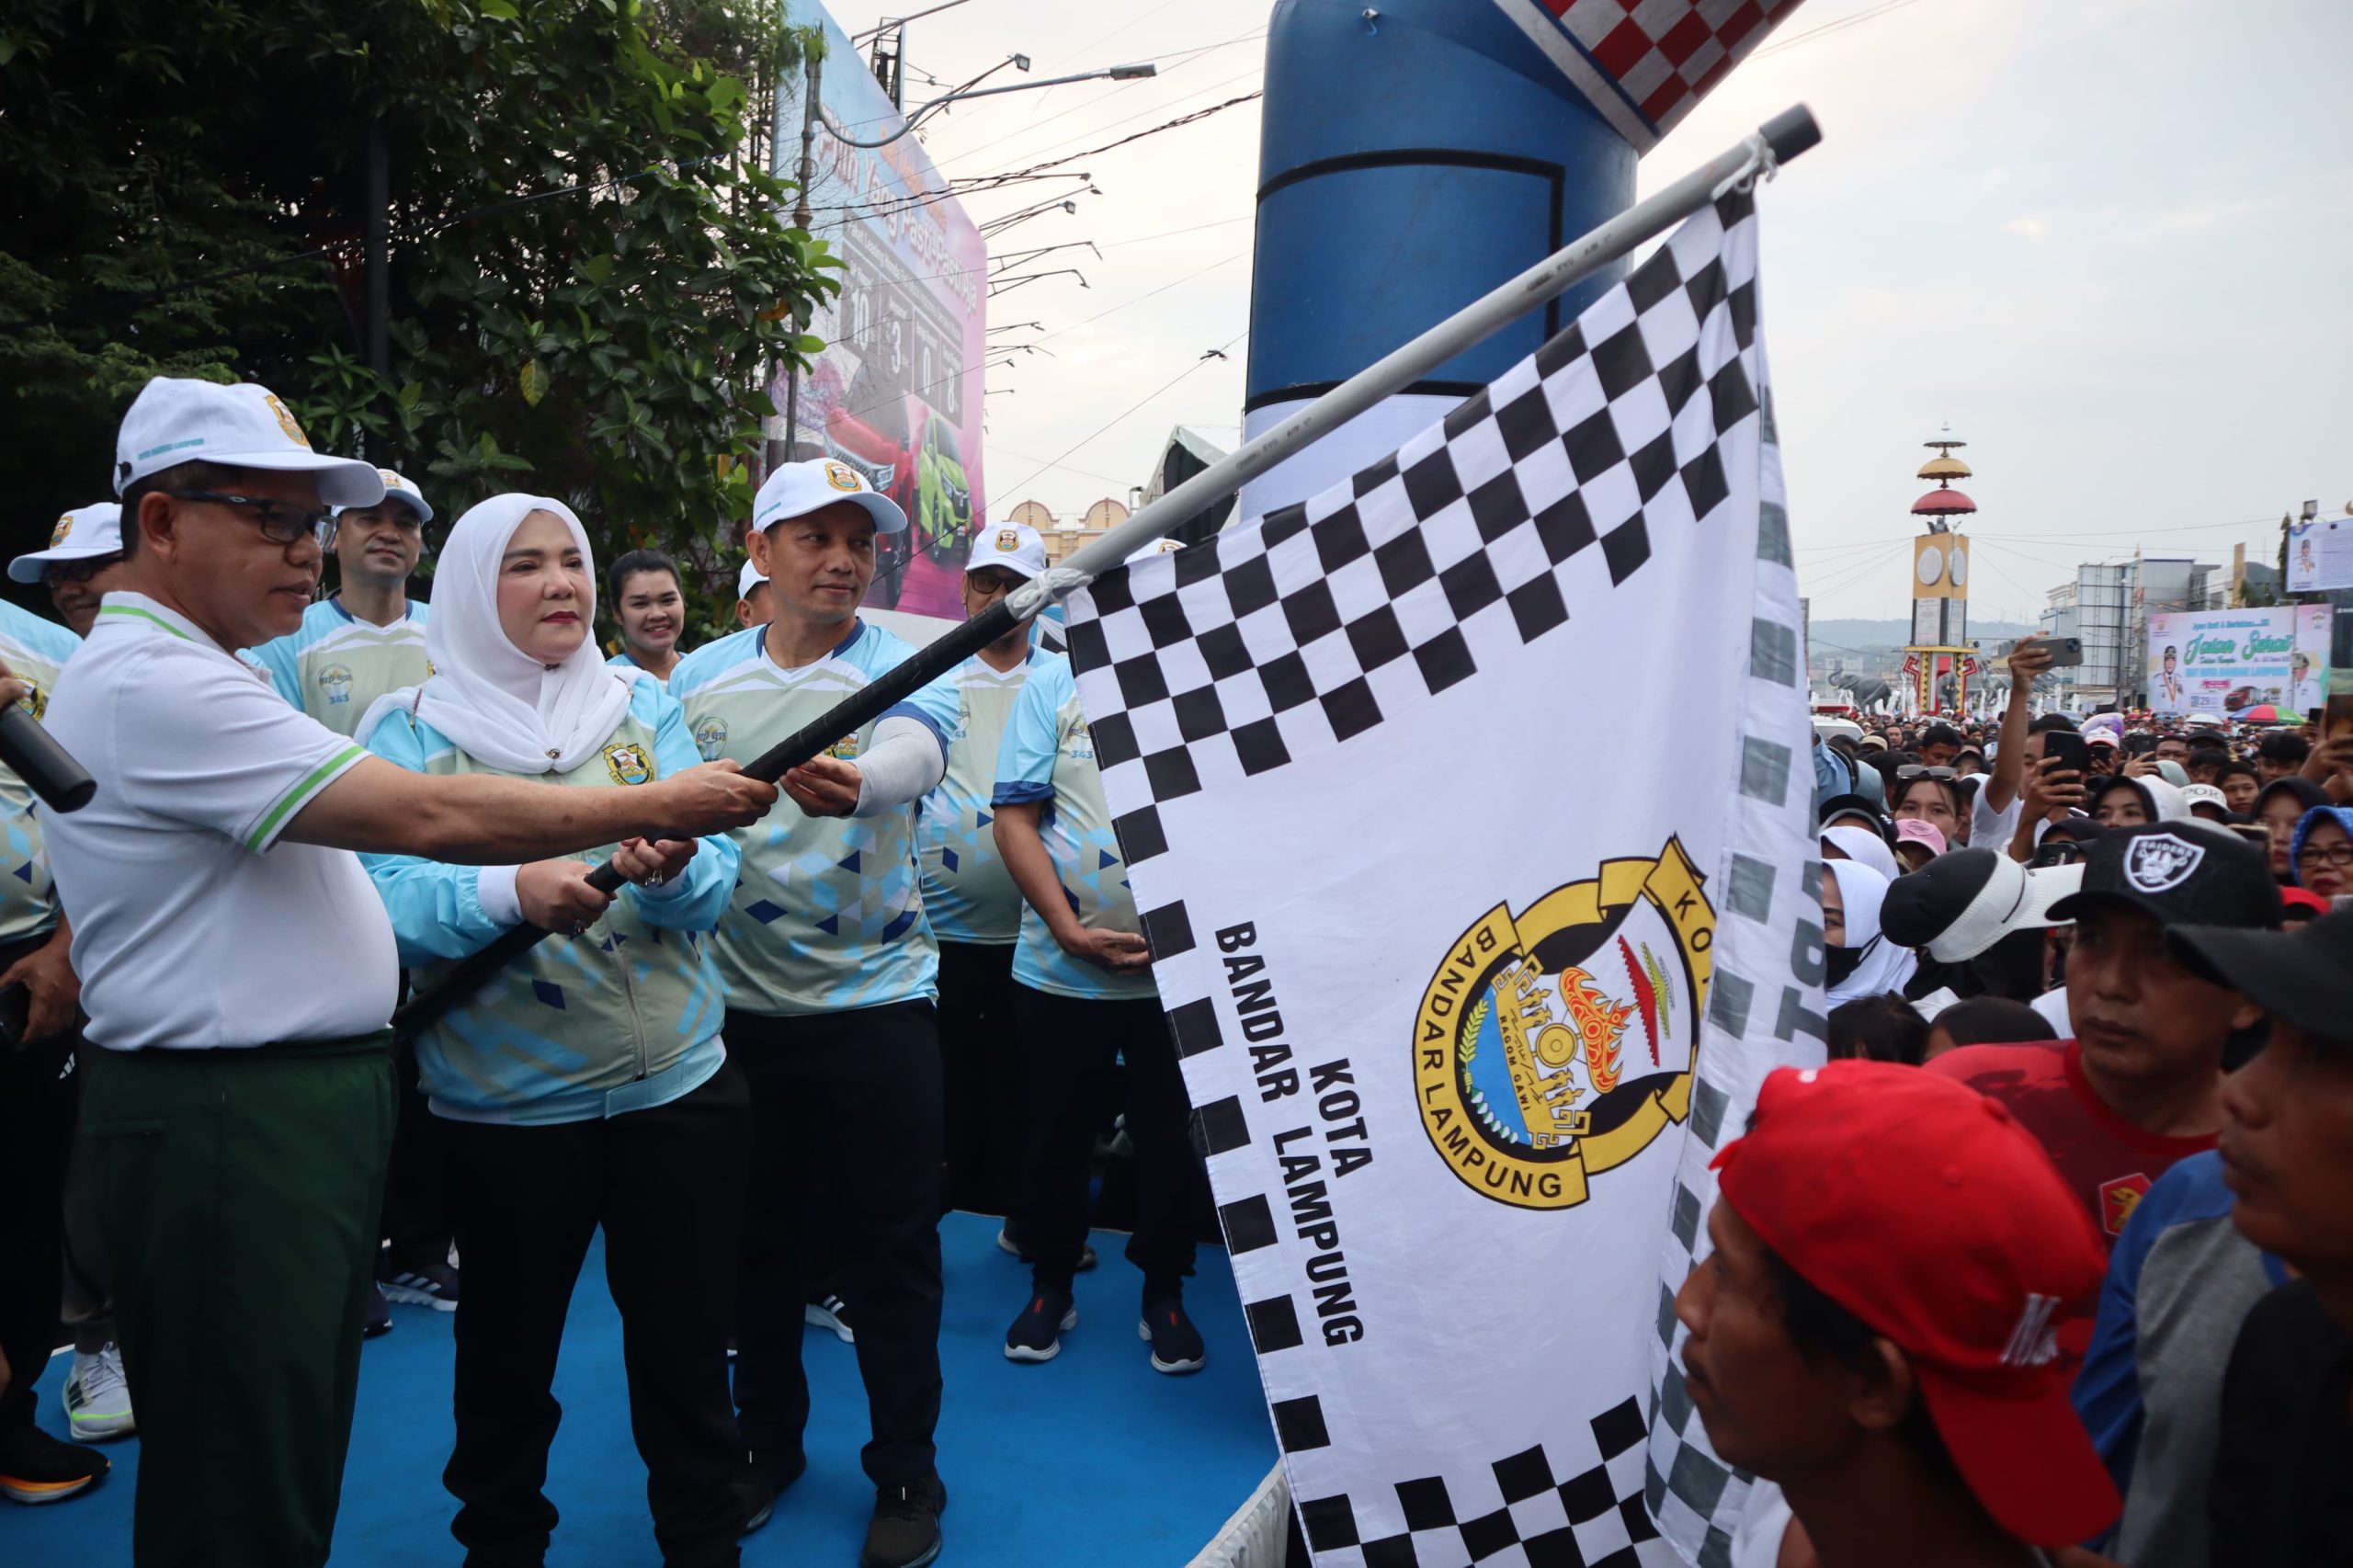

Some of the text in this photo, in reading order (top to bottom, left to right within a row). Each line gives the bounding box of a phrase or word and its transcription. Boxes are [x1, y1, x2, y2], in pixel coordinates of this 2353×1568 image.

[864, 149, 897, 240] Yang
[901, 191, 961, 298] Pasti-Pasti
[964, 267, 976, 321] Aja
[851, 283, 869, 353] 10
[892, 318, 901, 376] 3
[923, 343, 930, 397] 0
[948, 365, 954, 415] 8
[2139, 839, 2194, 858] RAIDERS
[1423, 925, 1563, 1199] BANDAR LAMPUNG
[1499, 1015, 1531, 1111] RAGOM GAWI
[1215, 920, 1364, 1347] BANDAR LAMPUNG
[1309, 1057, 1373, 1178] KOTA
